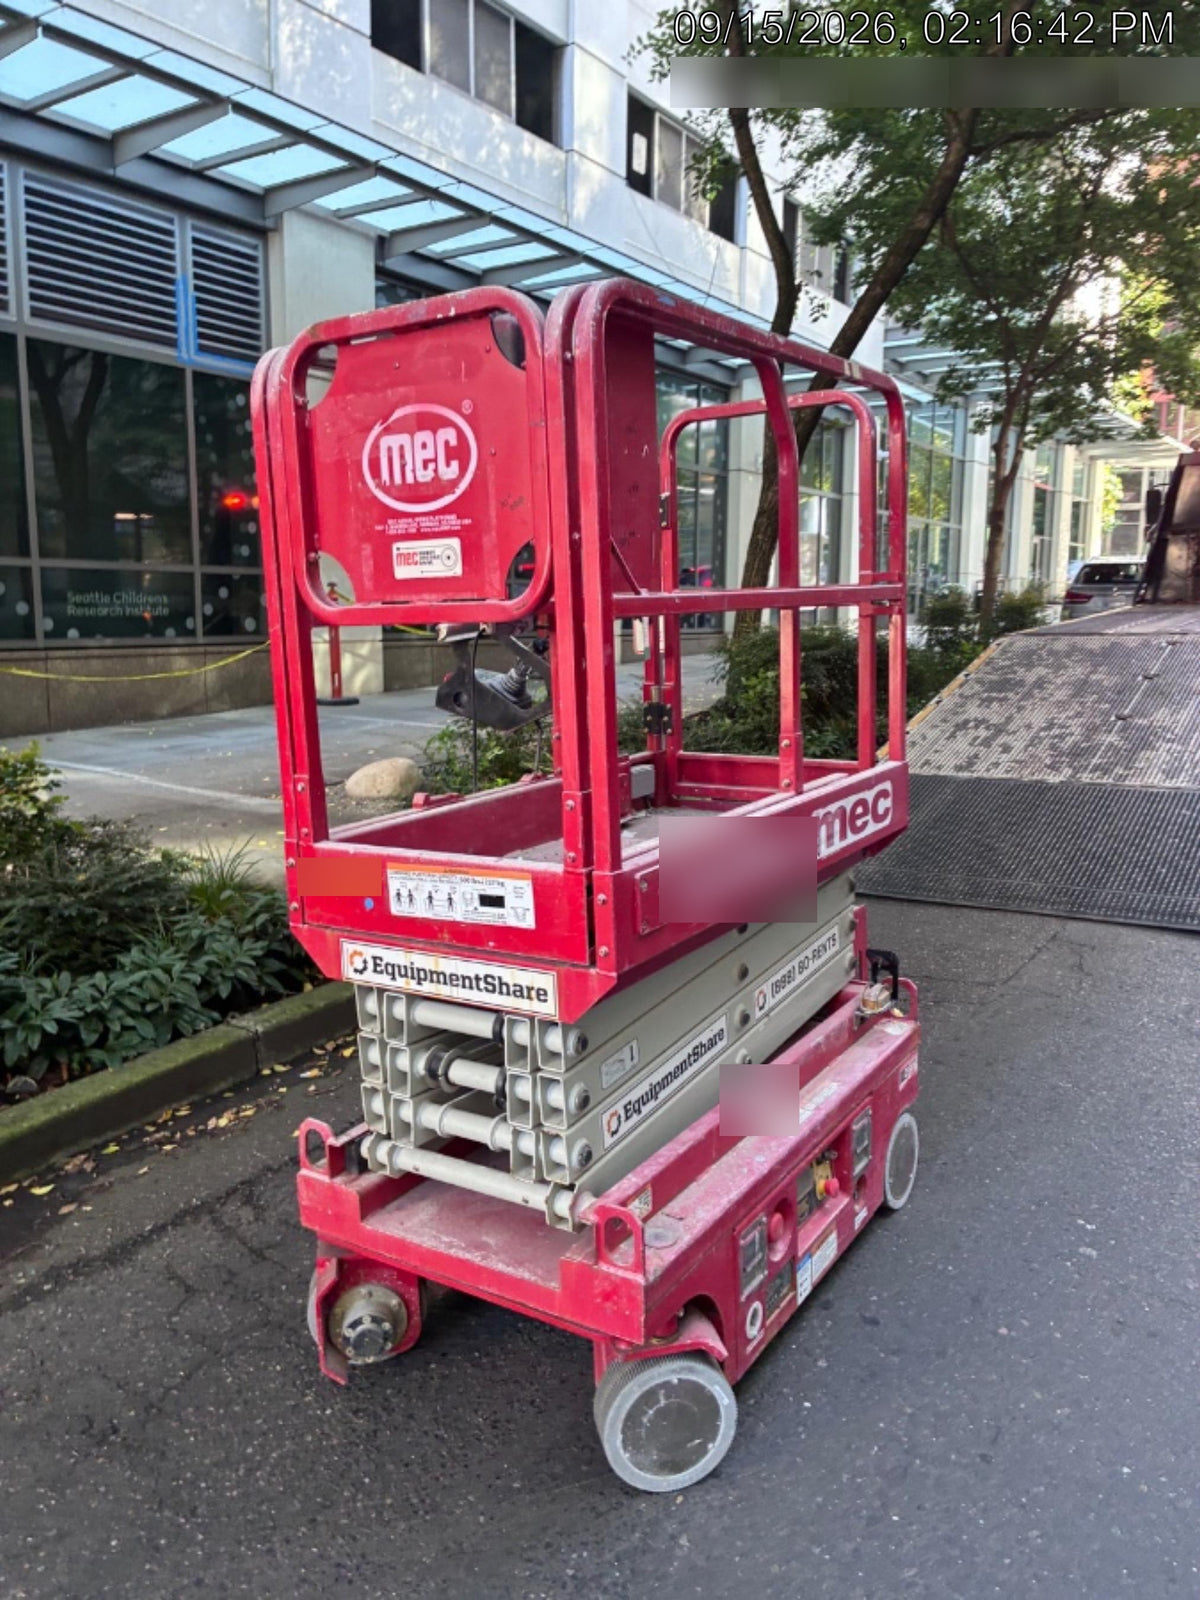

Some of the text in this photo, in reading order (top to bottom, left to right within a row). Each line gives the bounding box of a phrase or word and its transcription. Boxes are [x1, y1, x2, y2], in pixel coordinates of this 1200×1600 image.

[379, 426, 460, 486] mec
[67, 591, 111, 605] Seattle
[67, 605, 123, 617] Research
[816, 788, 892, 858] mec
[371, 954, 549, 1003] EquipmentShare
[623, 1026, 725, 1123] EquipmentShare
